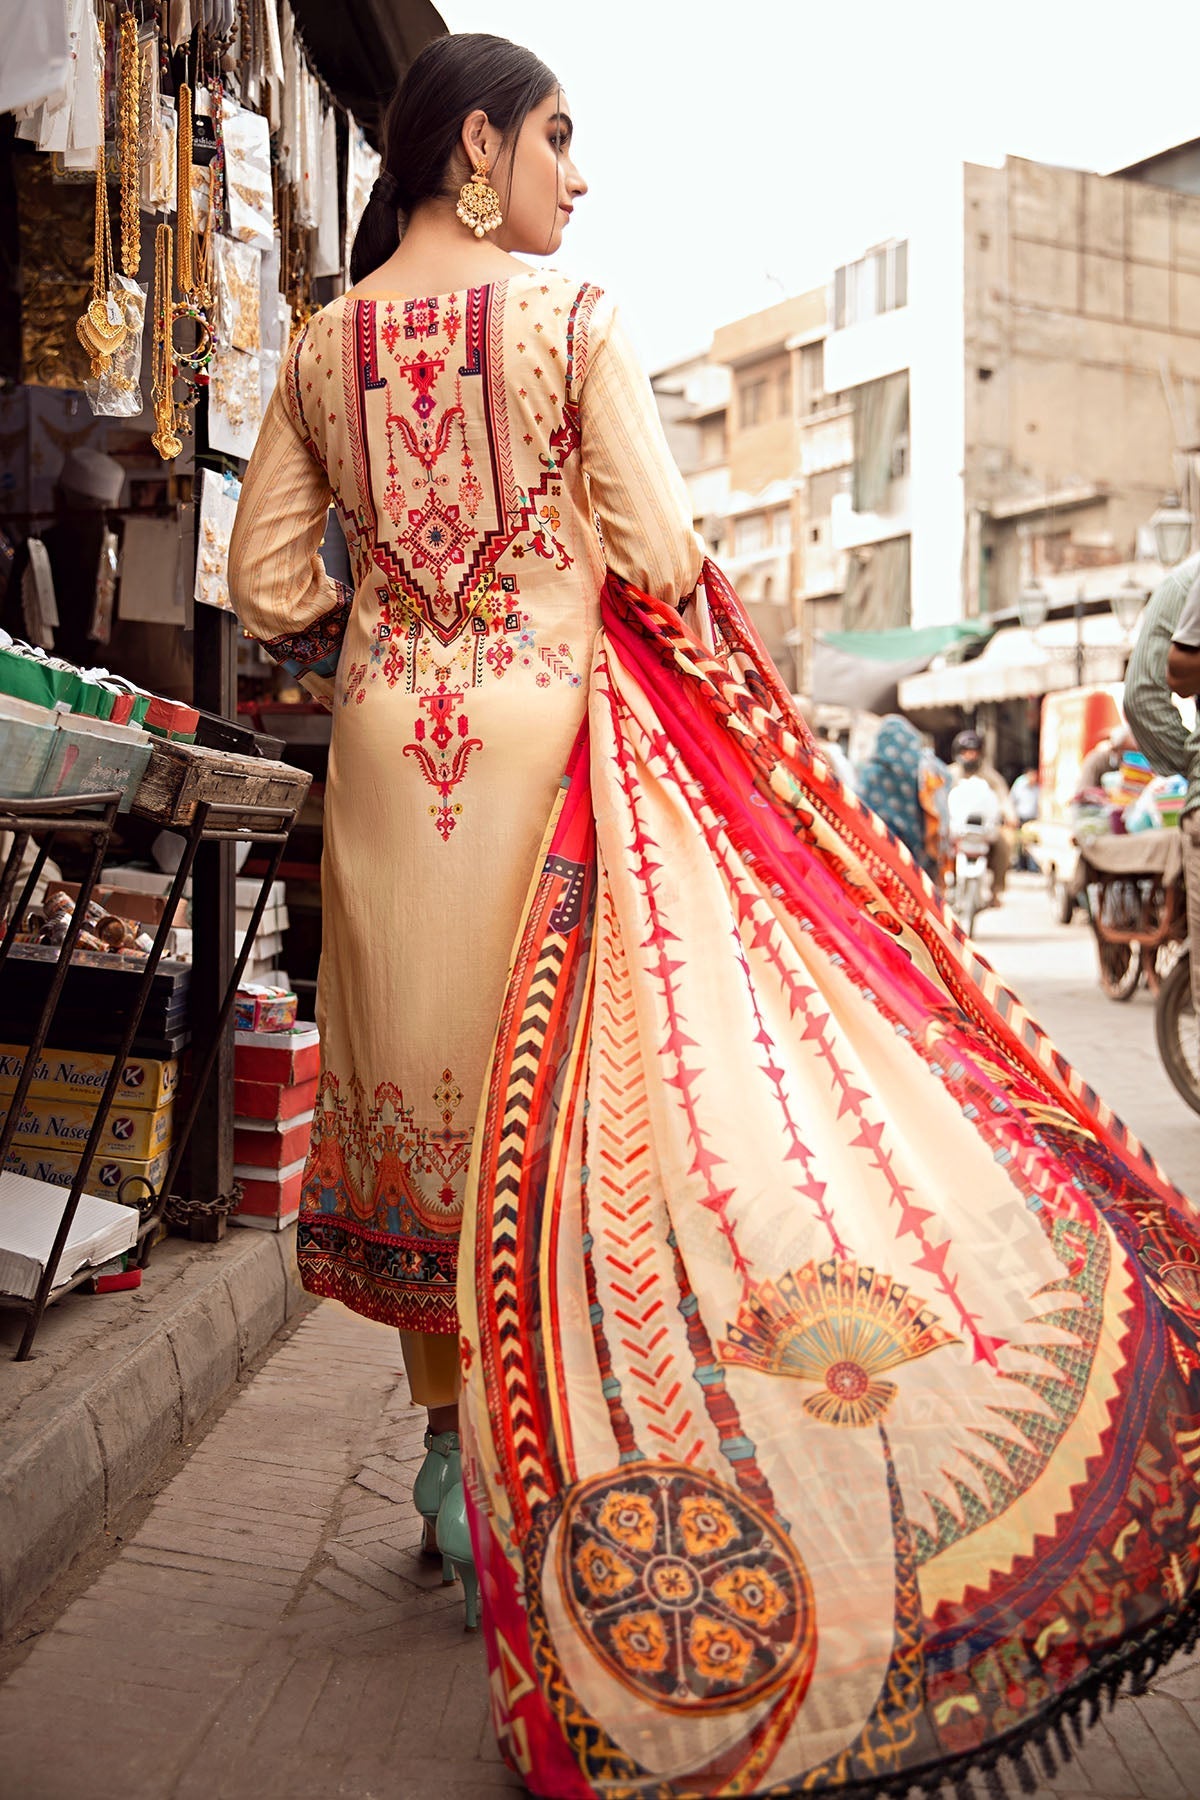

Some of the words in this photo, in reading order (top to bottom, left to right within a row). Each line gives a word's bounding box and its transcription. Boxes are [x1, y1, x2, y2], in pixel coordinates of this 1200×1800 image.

[0, 1056, 49, 1080] Khsh
[125, 1067, 143, 1085] K
[115, 1120, 131, 1138] K
[103, 1166, 119, 1184] K
